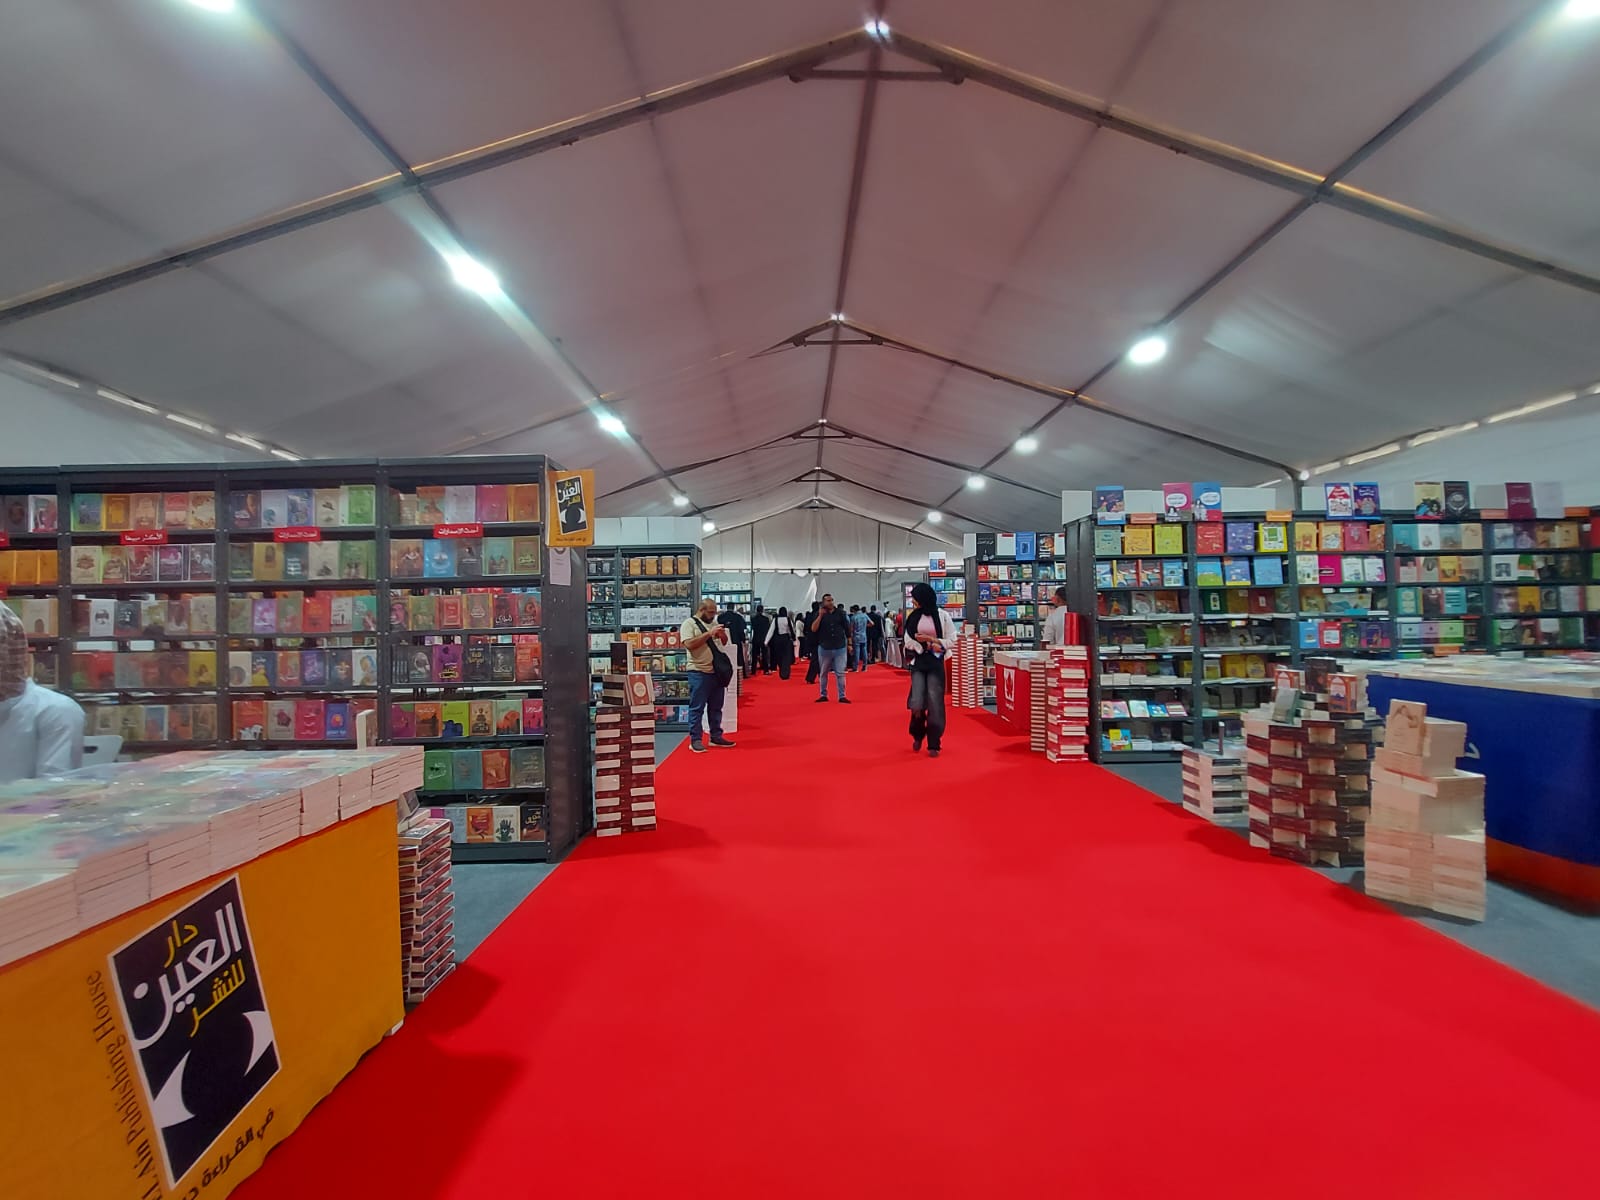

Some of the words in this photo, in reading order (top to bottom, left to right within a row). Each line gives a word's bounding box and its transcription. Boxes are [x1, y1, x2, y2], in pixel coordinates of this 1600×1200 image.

[558, 480, 581, 503] العين
[132, 901, 243, 1051] العين
[164, 919, 199, 968] دار
[86, 969, 116, 1044] House
[189, 958, 246, 1038] للنشر
[105, 1034, 146, 1146] Publishing
[201, 1126, 255, 1188] القراءة
